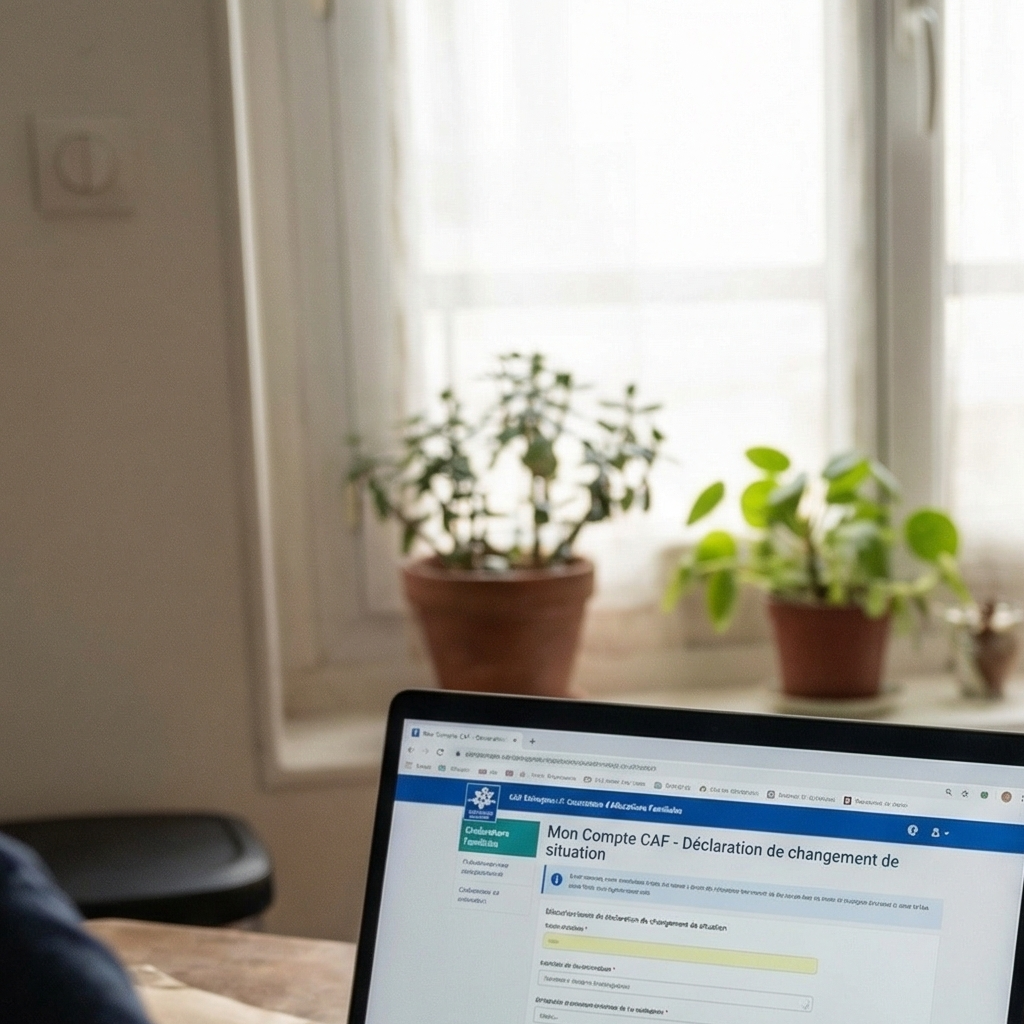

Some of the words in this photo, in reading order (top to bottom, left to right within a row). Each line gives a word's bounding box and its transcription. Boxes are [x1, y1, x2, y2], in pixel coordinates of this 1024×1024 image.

[545, 843, 607, 861] situation
[547, 825, 578, 841] Mon
[582, 828, 637, 847] Compte
[640, 833, 671, 848] CAF
[682, 836, 763, 857] Déclaration
[766, 844, 784, 858] de
[788, 846, 878, 867] changement
[881, 853, 900, 868] de
